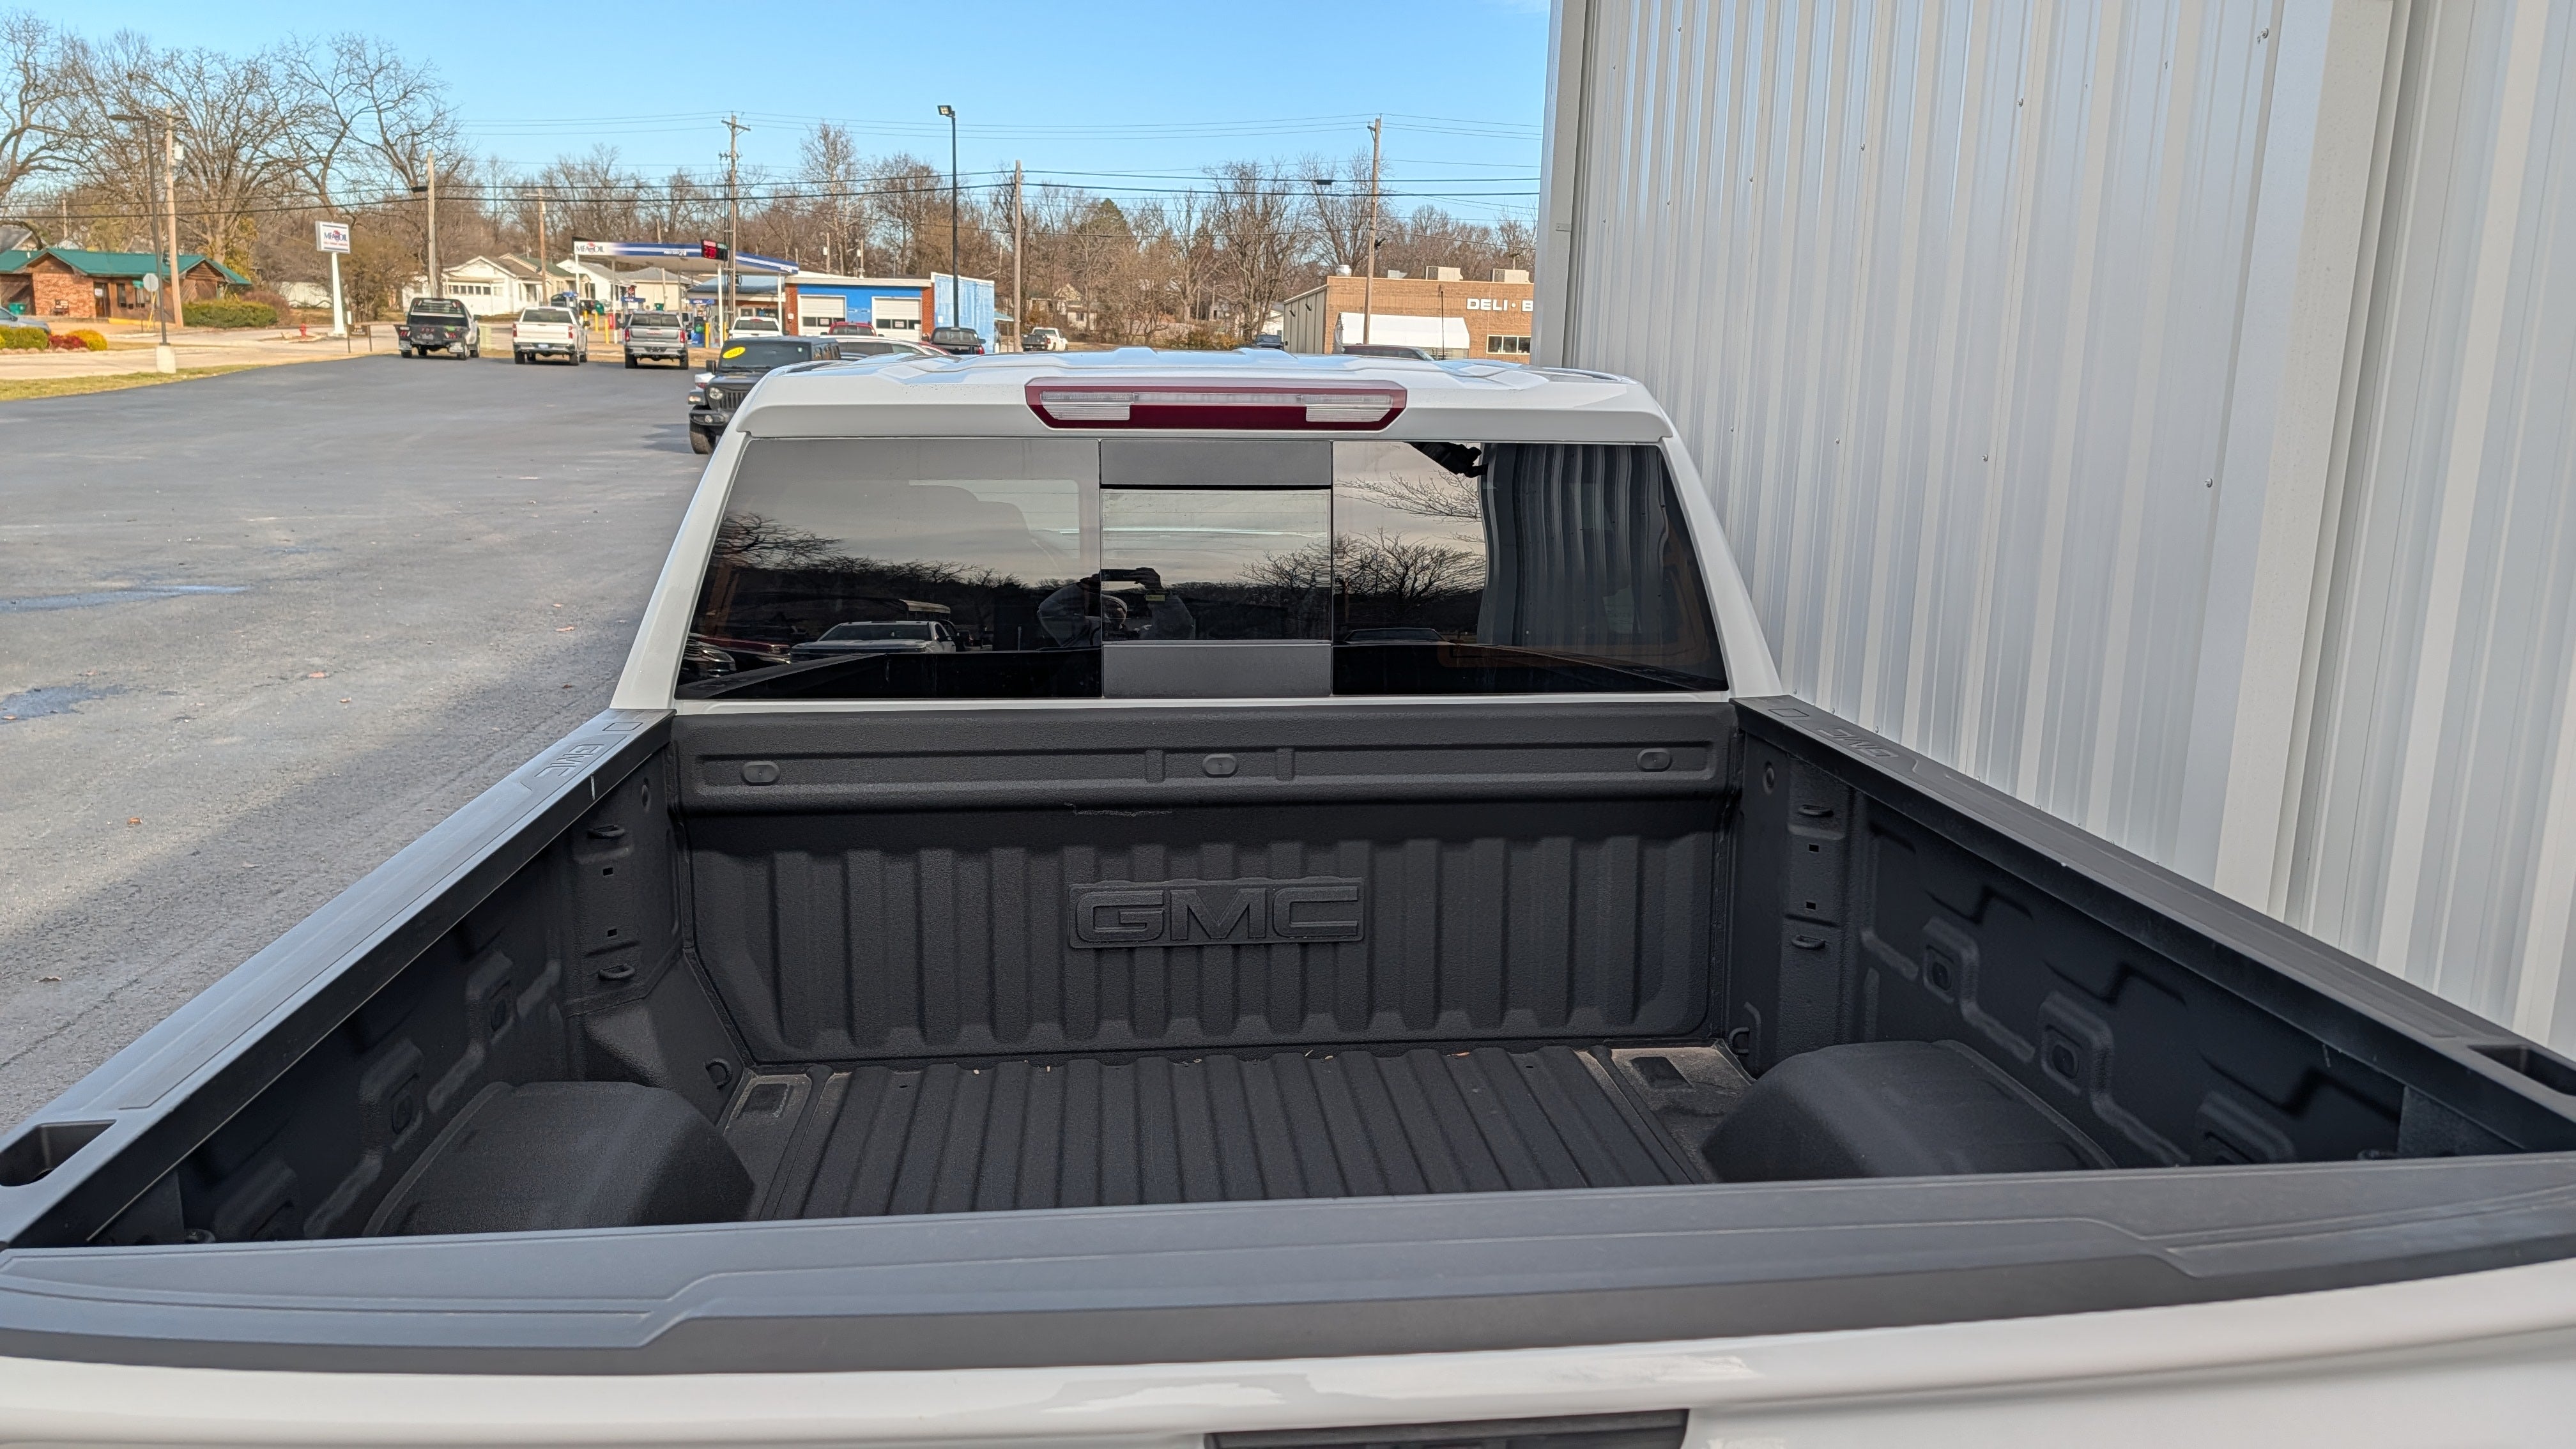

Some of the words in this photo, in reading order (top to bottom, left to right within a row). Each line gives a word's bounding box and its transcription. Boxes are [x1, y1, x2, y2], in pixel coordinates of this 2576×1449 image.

[1466, 298, 1508, 311] DELI
[535, 744, 605, 778] GMC
[1075, 885, 1359, 943] GMC
